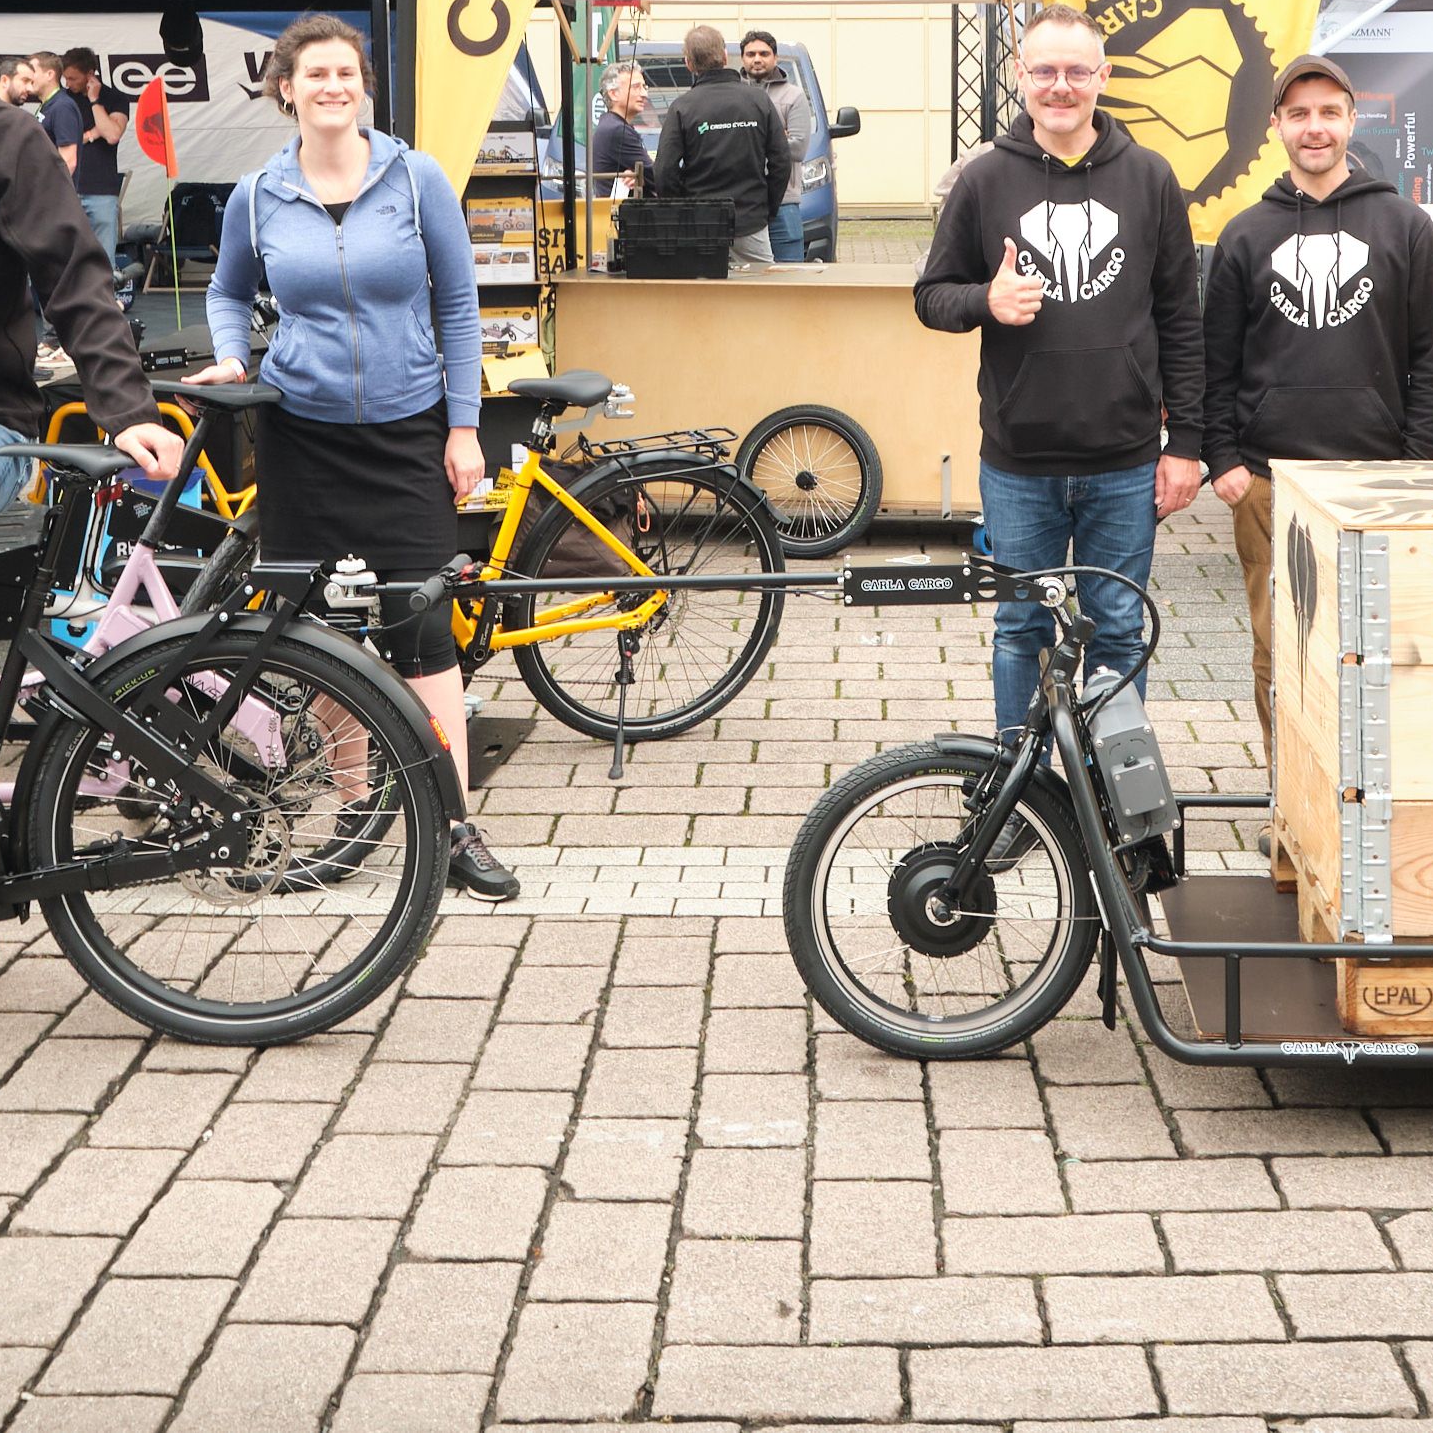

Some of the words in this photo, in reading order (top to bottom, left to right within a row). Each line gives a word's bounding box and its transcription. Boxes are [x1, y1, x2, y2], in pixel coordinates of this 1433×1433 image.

[1404, 112, 1416, 169] Powerful
[1412, 177, 1423, 204] dling
[1080, 247, 1126, 301] CARGO
[1270, 281, 1310, 328] CARLA
[1326, 277, 1375, 327] CARGO
[861, 579, 905, 591] CARLA
[908, 578, 953, 590] CARGO
[116, 669, 155, 696] PICK-UP
[65, 727, 89, 757] SCHW
[928, 768, 976, 777] PICK-UP
[1375, 986, 1423, 1005] EPAL
[1281, 1042, 1337, 1055] CARLA
[1362, 1042, 1419, 1055] CARGO
